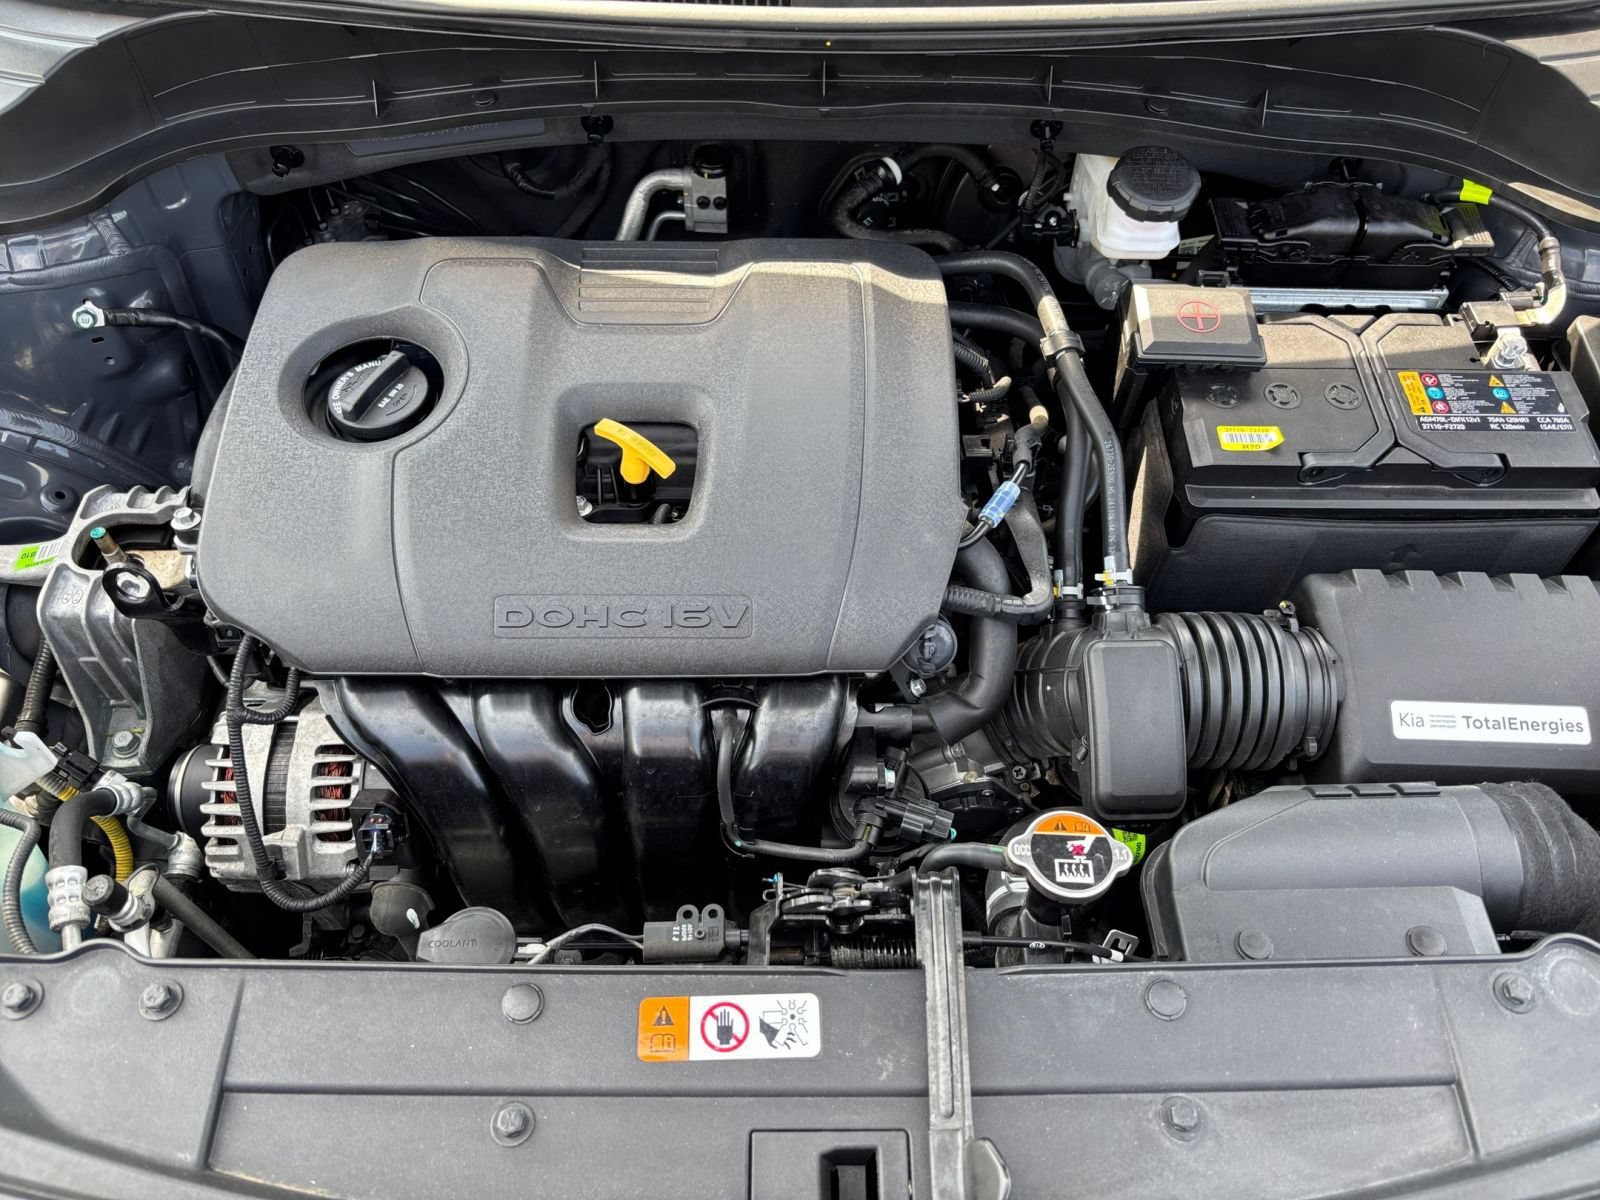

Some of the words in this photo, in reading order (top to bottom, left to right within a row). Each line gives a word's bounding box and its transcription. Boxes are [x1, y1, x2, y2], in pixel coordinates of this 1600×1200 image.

[331, 371, 355, 400] OWNER'S
[355, 360, 383, 372] MANU
[498, 604, 648, 628] DOHC
[663, 604, 750, 628] 16V
[1399, 711, 1425, 728] Kia
[1461, 715, 1584, 735] TotalEnergies
[428, 939, 477, 949] COOLANT
